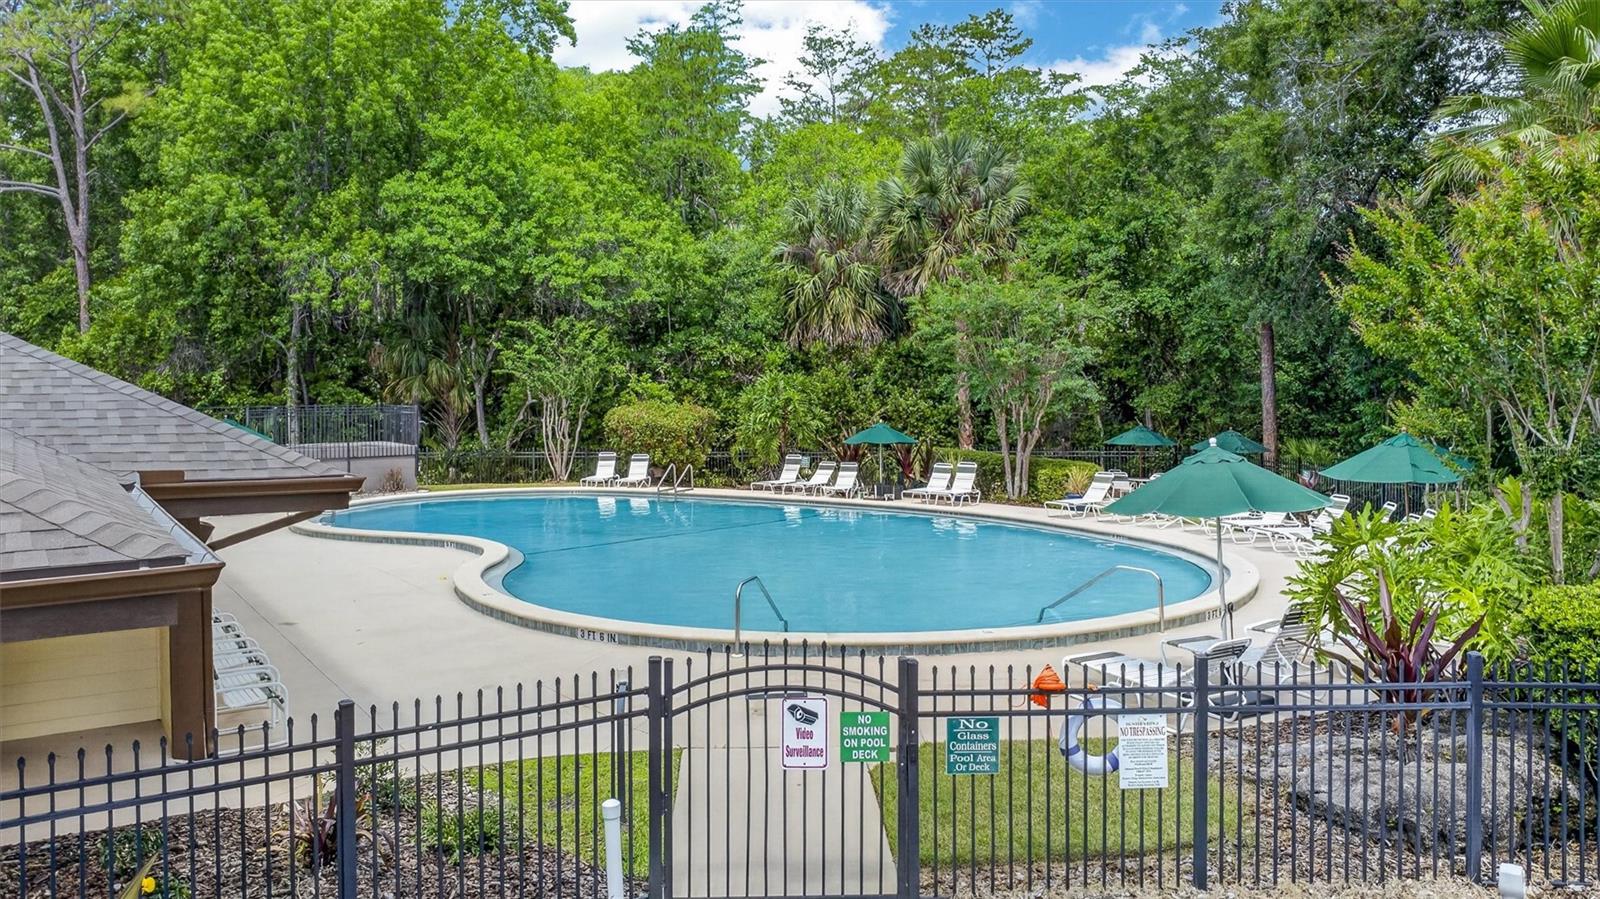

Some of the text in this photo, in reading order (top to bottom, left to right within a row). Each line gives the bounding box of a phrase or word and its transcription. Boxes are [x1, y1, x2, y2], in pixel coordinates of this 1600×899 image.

[580, 629, 585, 638] 3
[599, 632, 605, 641] 6
[857, 714, 872, 724] NO
[959, 718, 989, 729] No
[795, 727, 814, 740] Video
[842, 726, 888, 736] SMOKING
[957, 731, 990, 740] Glass
[1120, 726, 1166, 737] NO TRESPASSING
[843, 738, 886, 748] ON POOL
[949, 741, 997, 751] Containers
[785, 744, 824, 758] Surveillance
[852, 749, 879, 759] DECK
[949, 753, 996, 762] Pool Area
[955, 763, 990, 772] Or Deck
